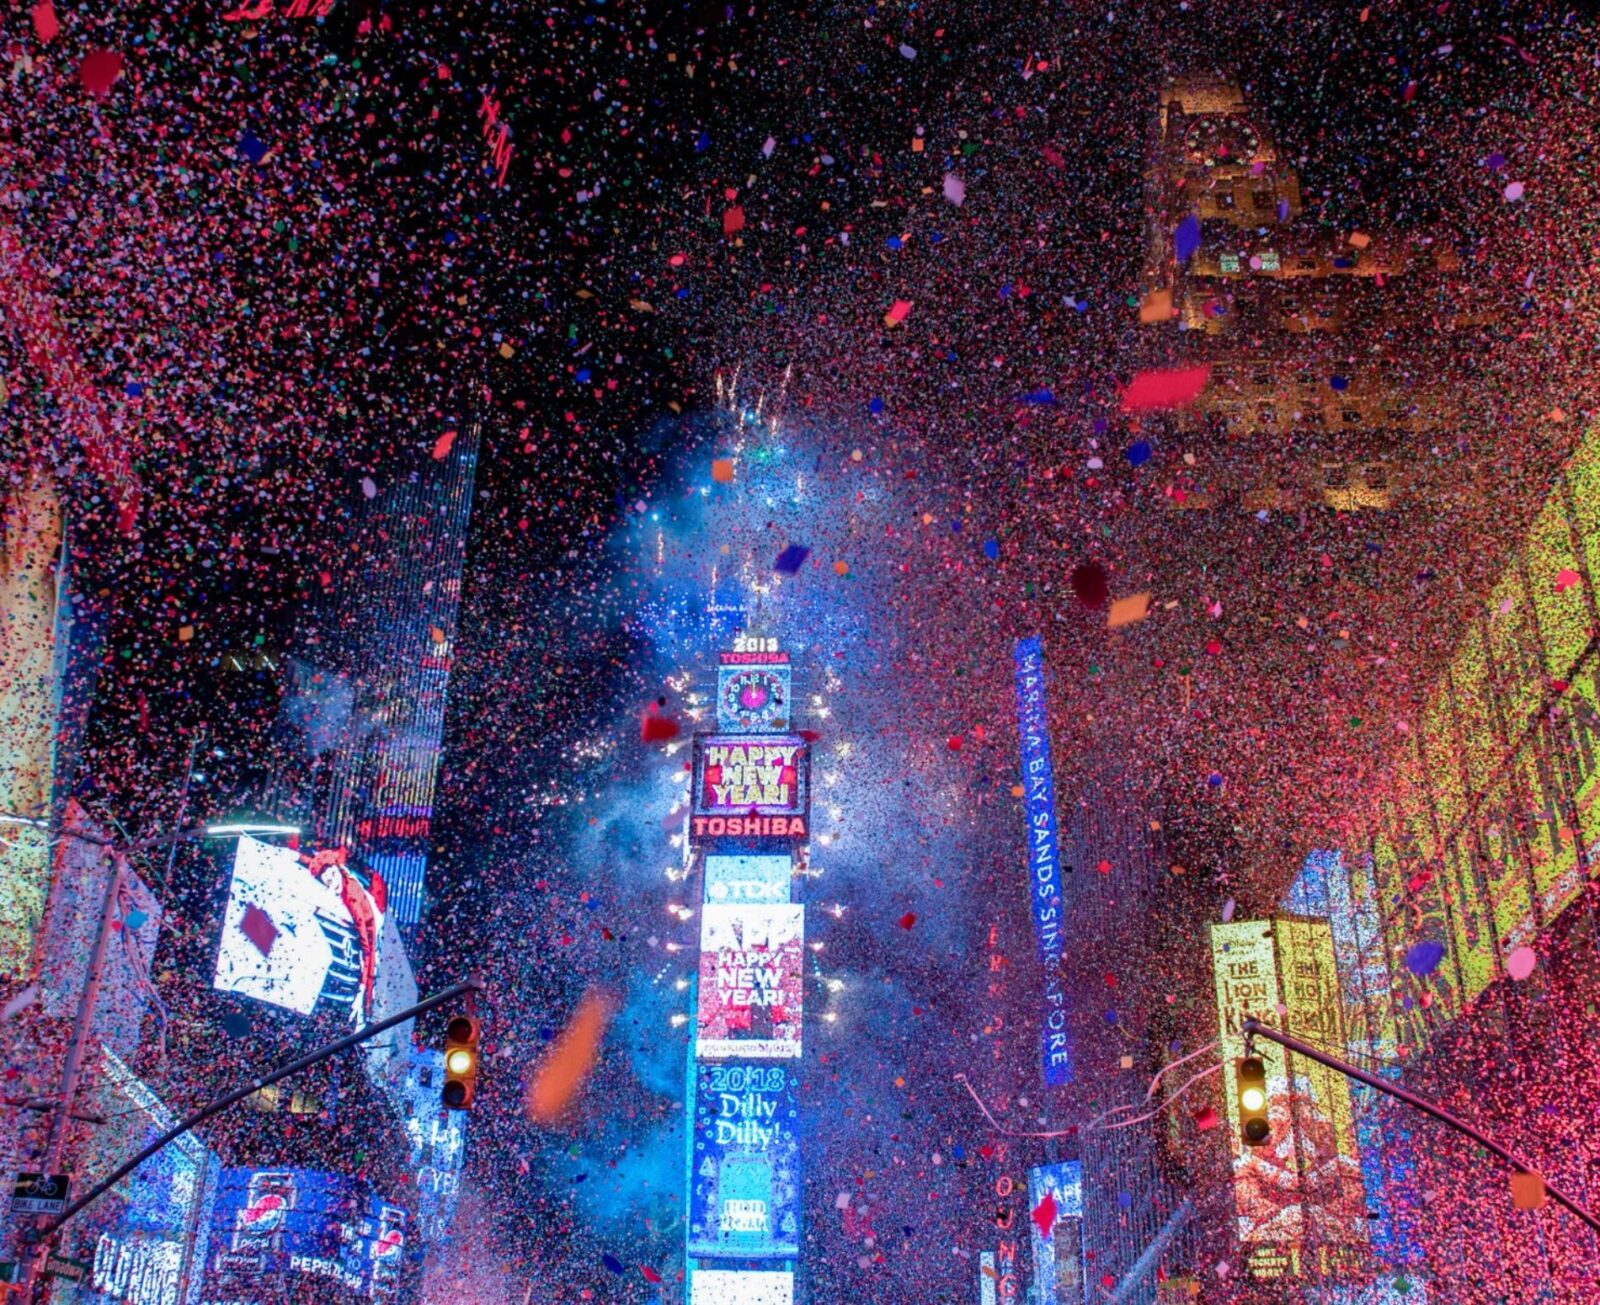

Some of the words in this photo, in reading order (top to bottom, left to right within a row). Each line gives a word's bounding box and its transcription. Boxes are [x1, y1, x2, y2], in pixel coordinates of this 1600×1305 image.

[720, 653, 789, 664] TOSHIBA
[708, 746, 796, 767] HAPPY
[721, 766, 784, 786] NEW
[1029, 757, 1048, 803] BAY
[712, 784, 789, 805] YEAR!
[693, 817, 806, 836] TOSHIBA
[1033, 813, 1055, 898] SANDS
[718, 952, 784, 967] HAPPY
[1227, 960, 1259, 976] THE
[717, 967, 785, 988] NEW
[718, 989, 785, 1006] YEAR!
[719, 1093, 777, 1124] Dilly
[715, 1119, 781, 1151] Dilly!
[14, 1200, 33, 1210] BIKE
[37, 1201, 61, 1212] LANE
